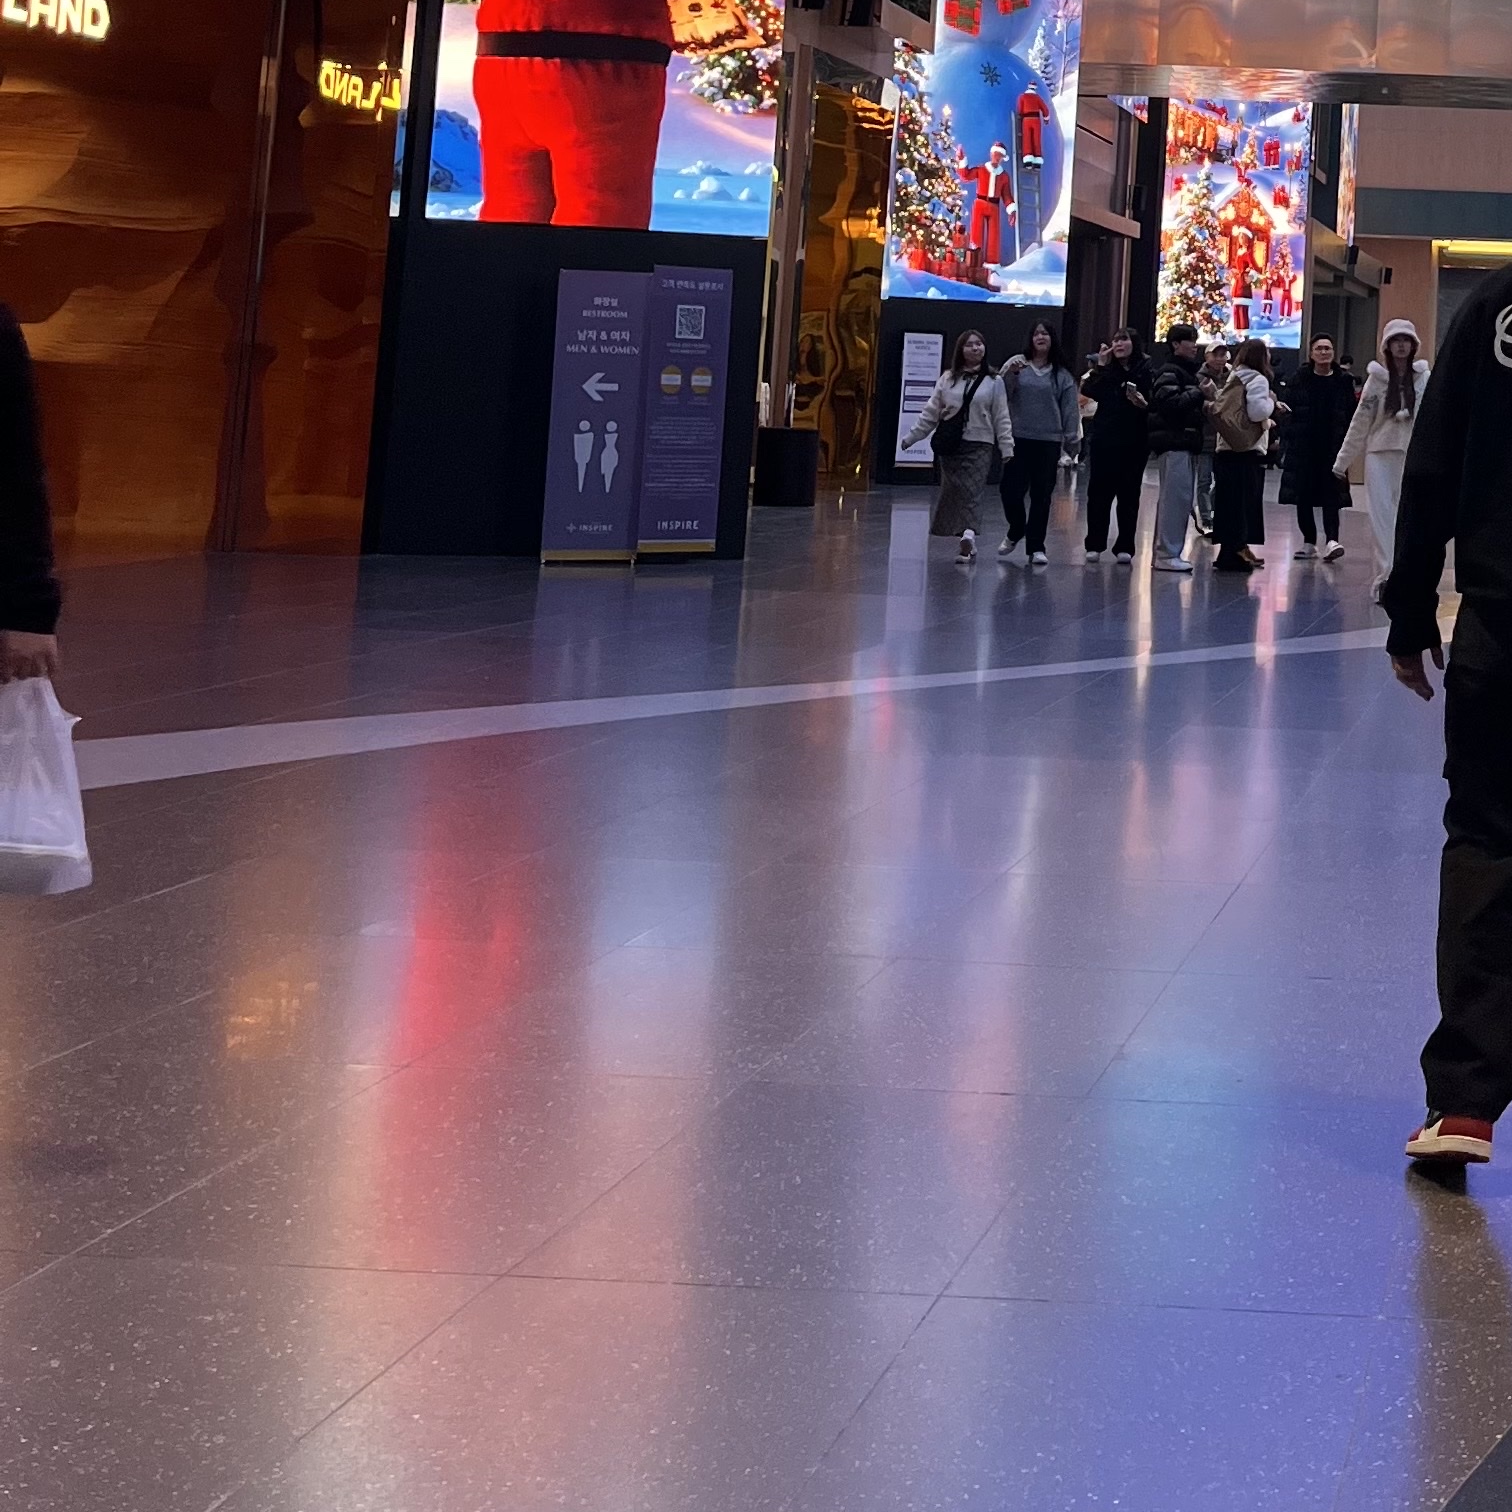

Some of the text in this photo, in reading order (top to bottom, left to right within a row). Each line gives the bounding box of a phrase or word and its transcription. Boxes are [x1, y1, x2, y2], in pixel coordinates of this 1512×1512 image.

[582, 309, 628, 318] RESTROOM
[577, 329, 630, 342] 남자 & 여자
[566, 344, 640, 355] MEN & WOMEN
[578, 524, 614, 532] INSPIRE
[657, 520, 700, 530] INSPIRE
